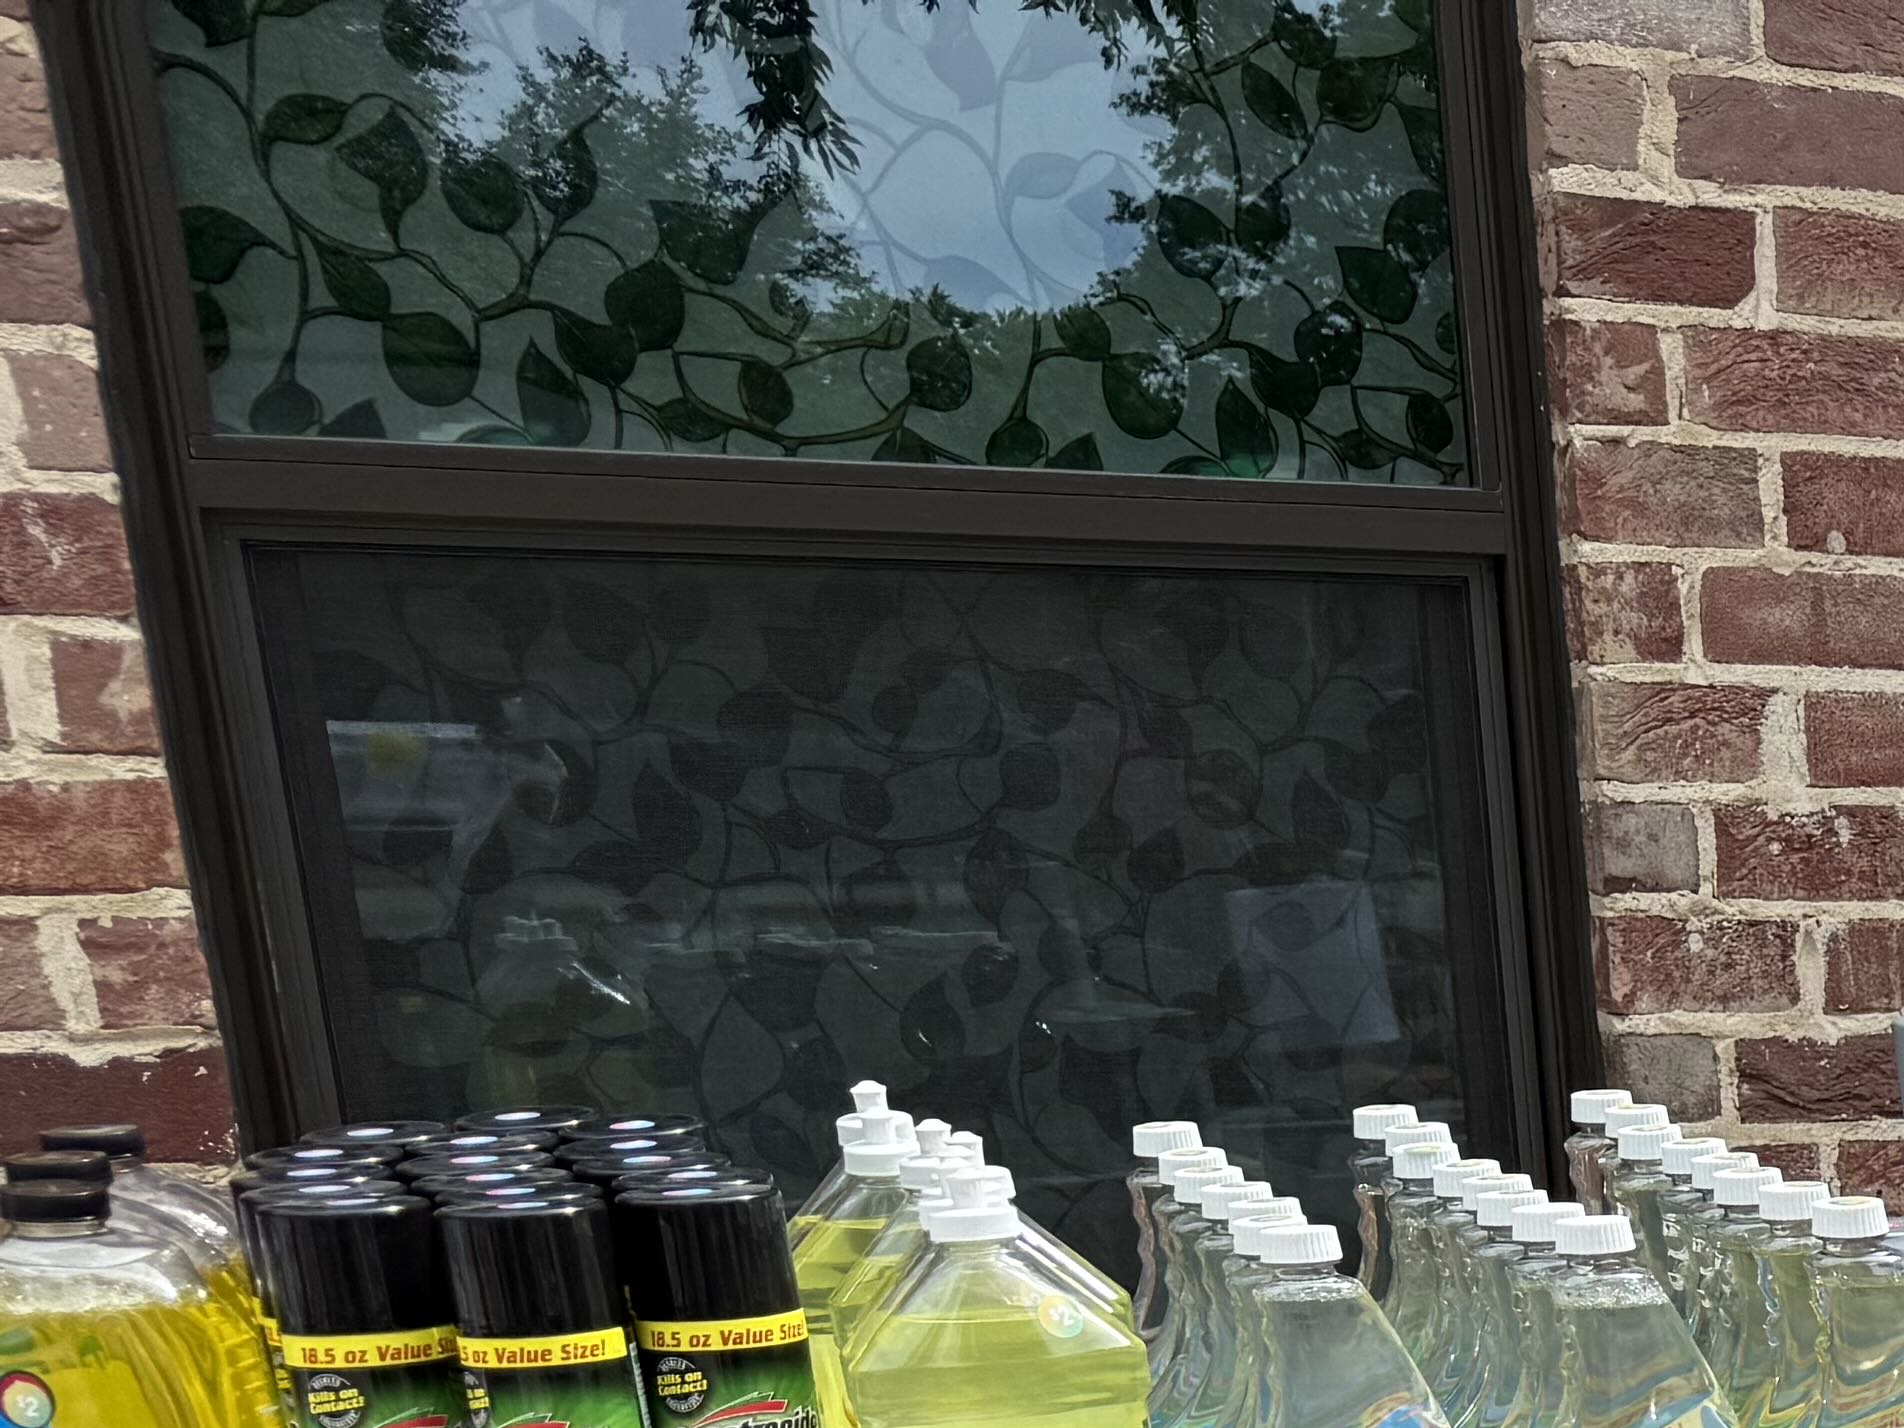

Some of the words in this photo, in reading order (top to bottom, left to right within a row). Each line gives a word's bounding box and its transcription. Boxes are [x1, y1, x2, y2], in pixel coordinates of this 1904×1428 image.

[651, 1330, 682, 1349] 18.5
[688, 1334, 712, 1348] oz
[720, 1327, 775, 1347] Value
[300, 1346, 336, 1365] 18.5
[344, 1347, 369, 1364] oz
[376, 1340, 433, 1362] Value
[473, 1349, 489, 1364] oz
[494, 1347, 553, 1364] Value
[560, 1339, 607, 1361] Size!
[308, 1390, 336, 1405] Kills
[339, 1388, 358, 1400] on
